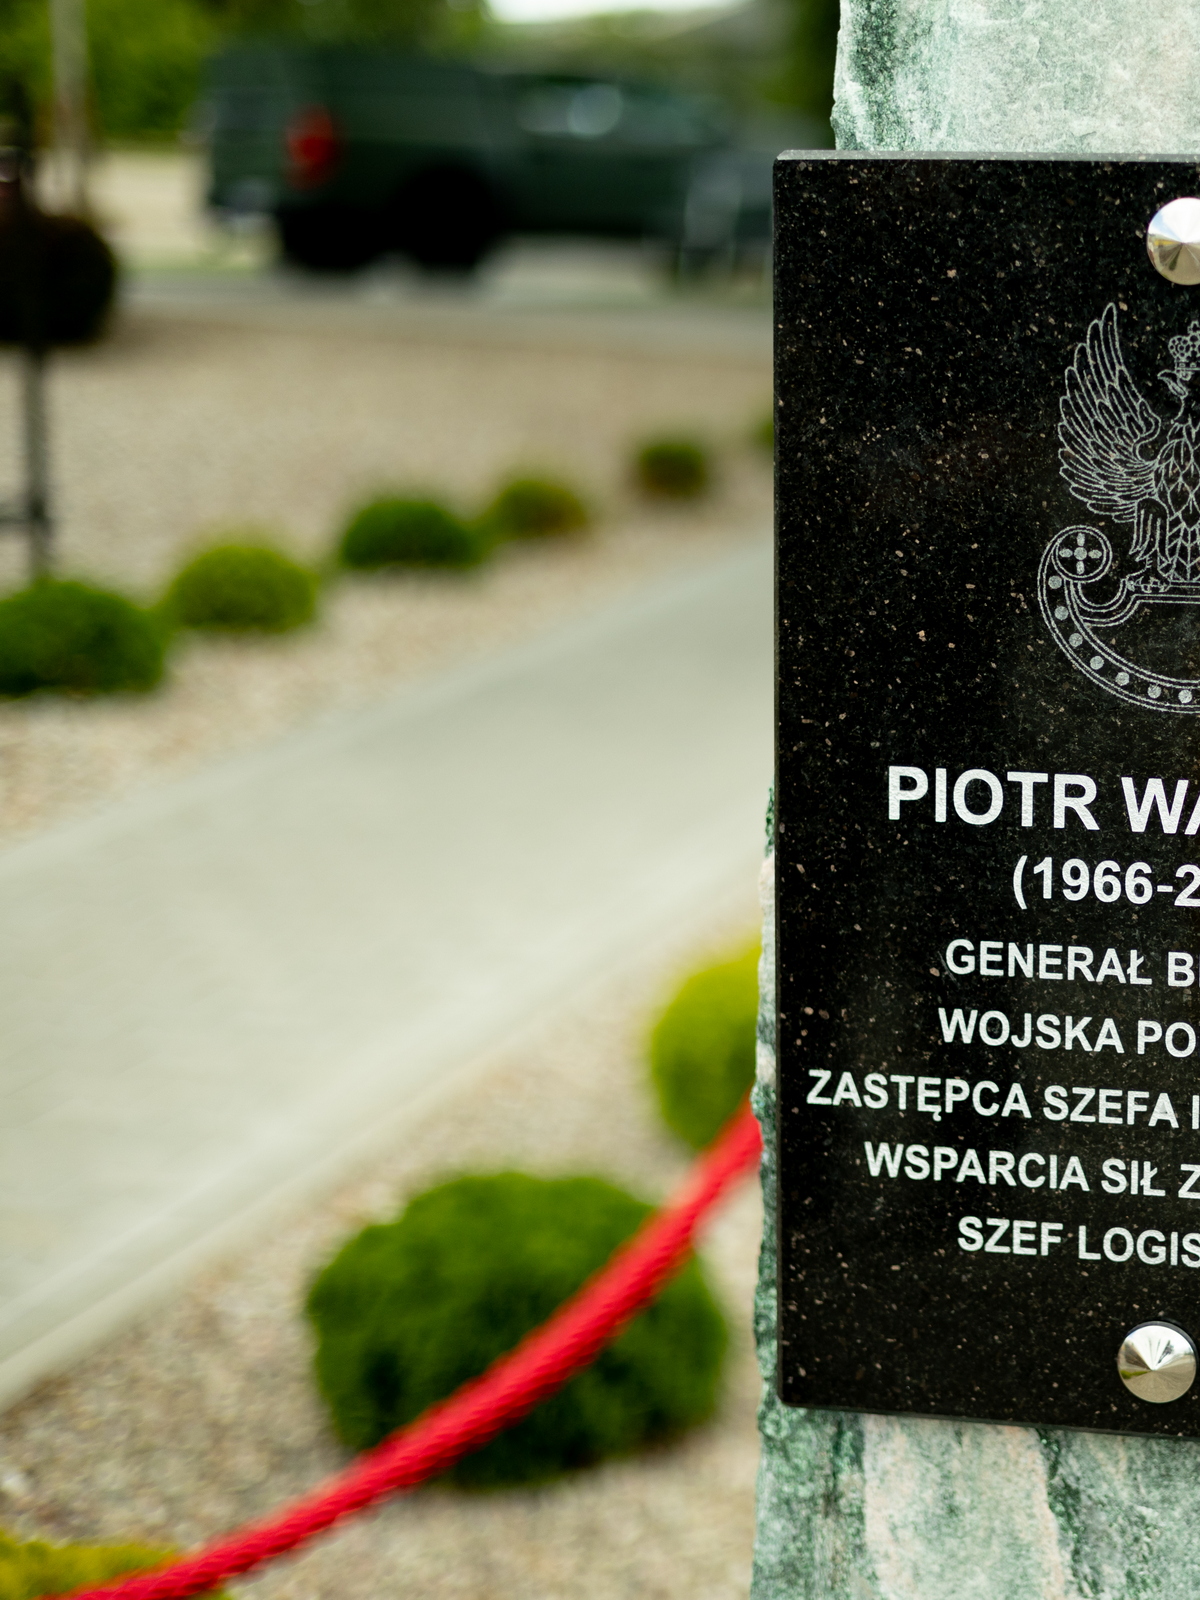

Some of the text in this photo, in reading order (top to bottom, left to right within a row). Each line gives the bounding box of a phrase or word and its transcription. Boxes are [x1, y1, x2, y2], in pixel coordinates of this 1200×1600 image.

[888, 765, 1100, 831] PIOTR
[945, 938, 1153, 985] GENERAŁ
[938, 1007, 1125, 1054] WOJSKA
[806, 1069, 1032, 1122] ZASTĘPCA
[1042, 1085, 1180, 1129] SZEFA
[864, 1141, 1090, 1192] WSPARCIA
[1101, 1158, 1166, 1197] SIŁ
[957, 1216, 1064, 1256] SZEF
